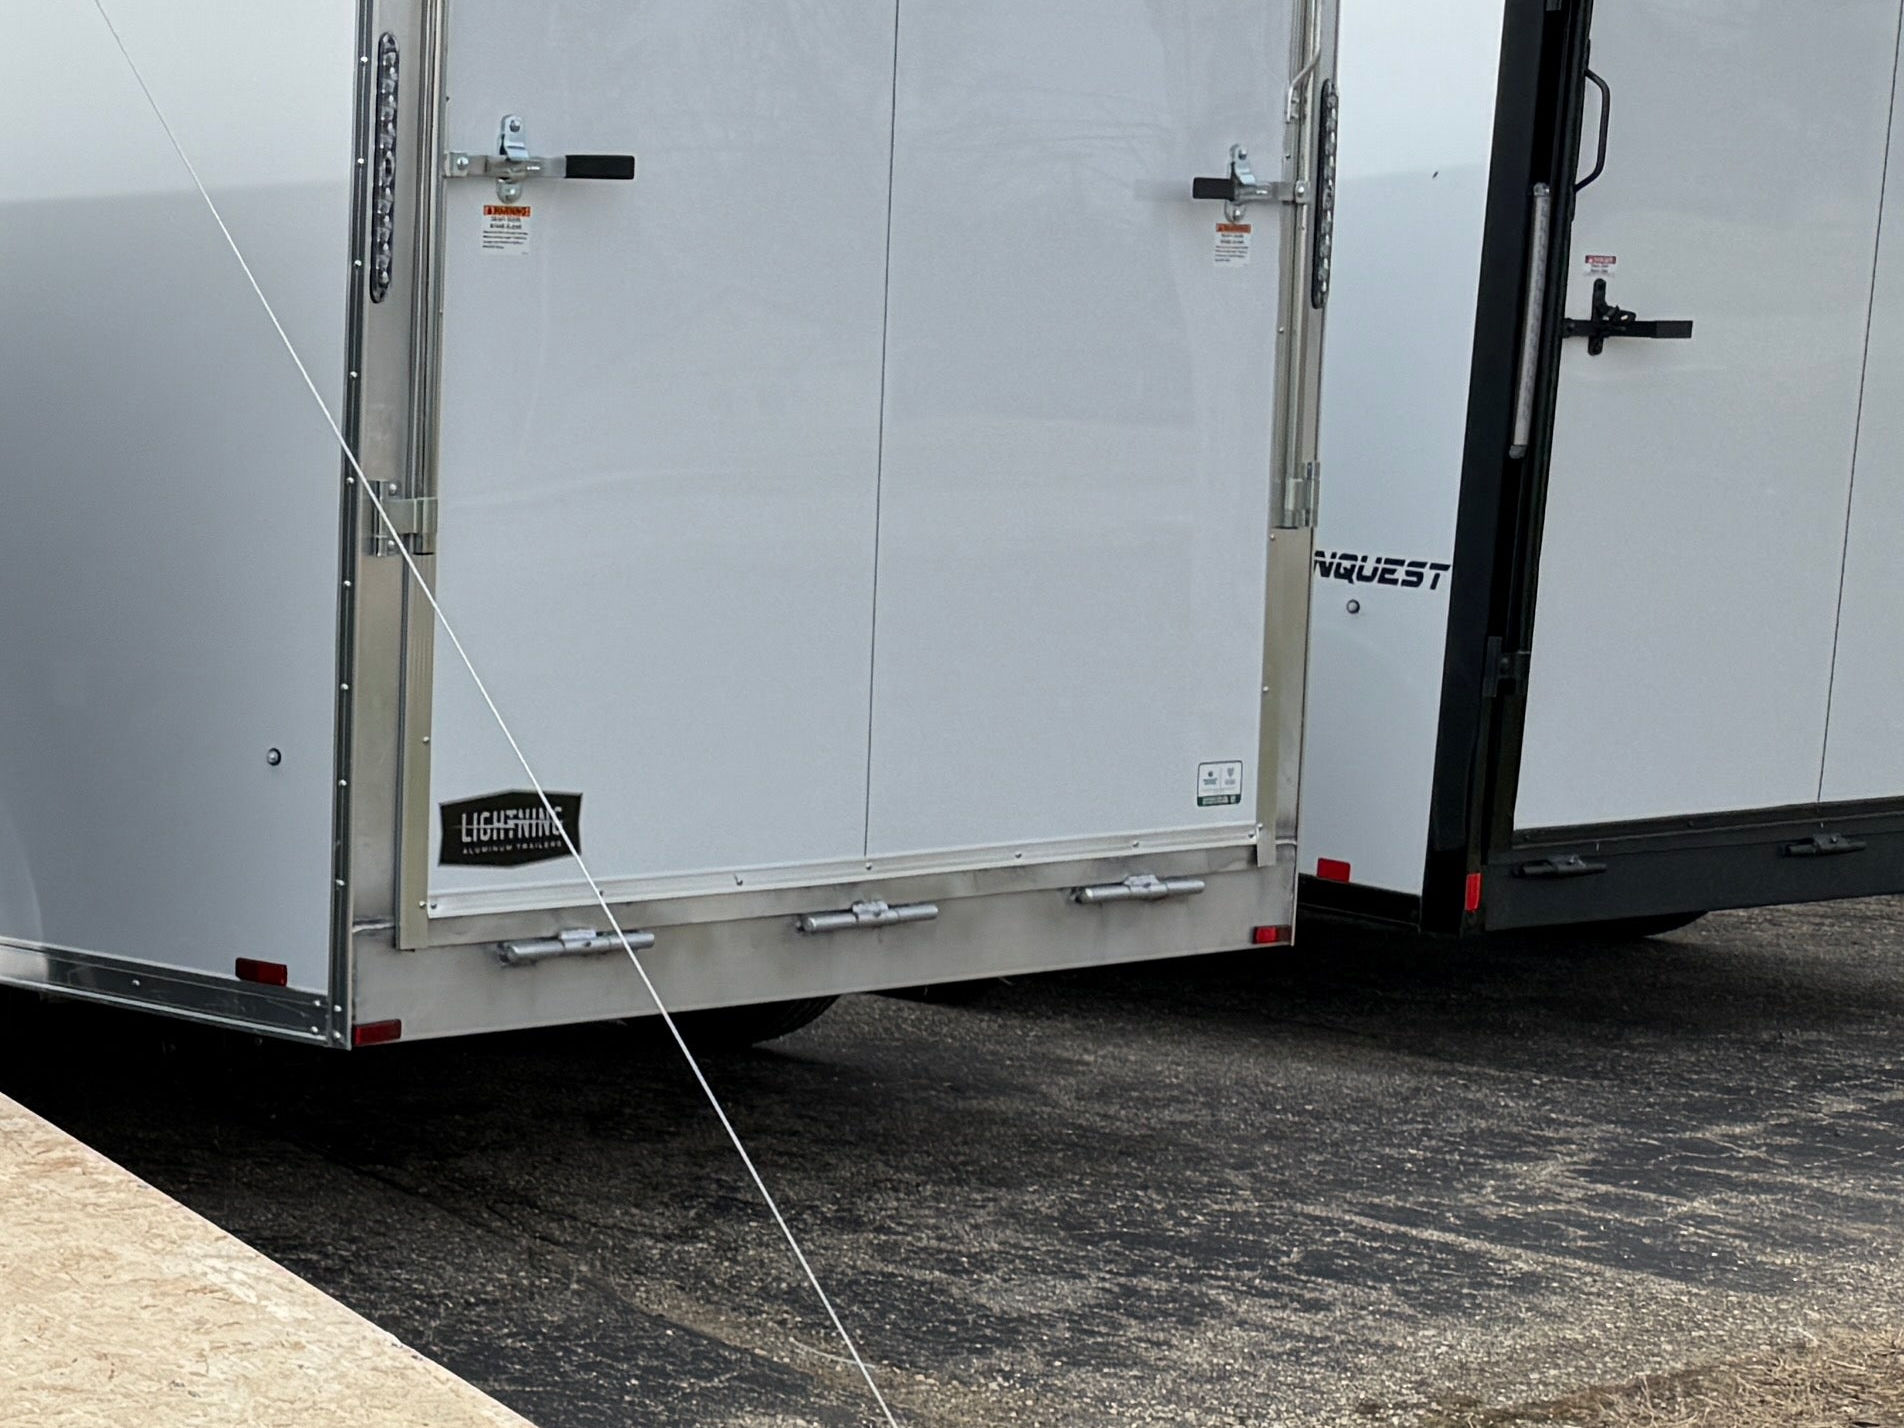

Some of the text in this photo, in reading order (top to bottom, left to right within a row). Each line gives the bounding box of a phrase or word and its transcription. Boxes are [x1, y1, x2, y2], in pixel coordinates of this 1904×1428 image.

[1314, 549, 1452, 591] NQUEST
[462, 840, 563, 855] ALUMINUM TRAILERS
